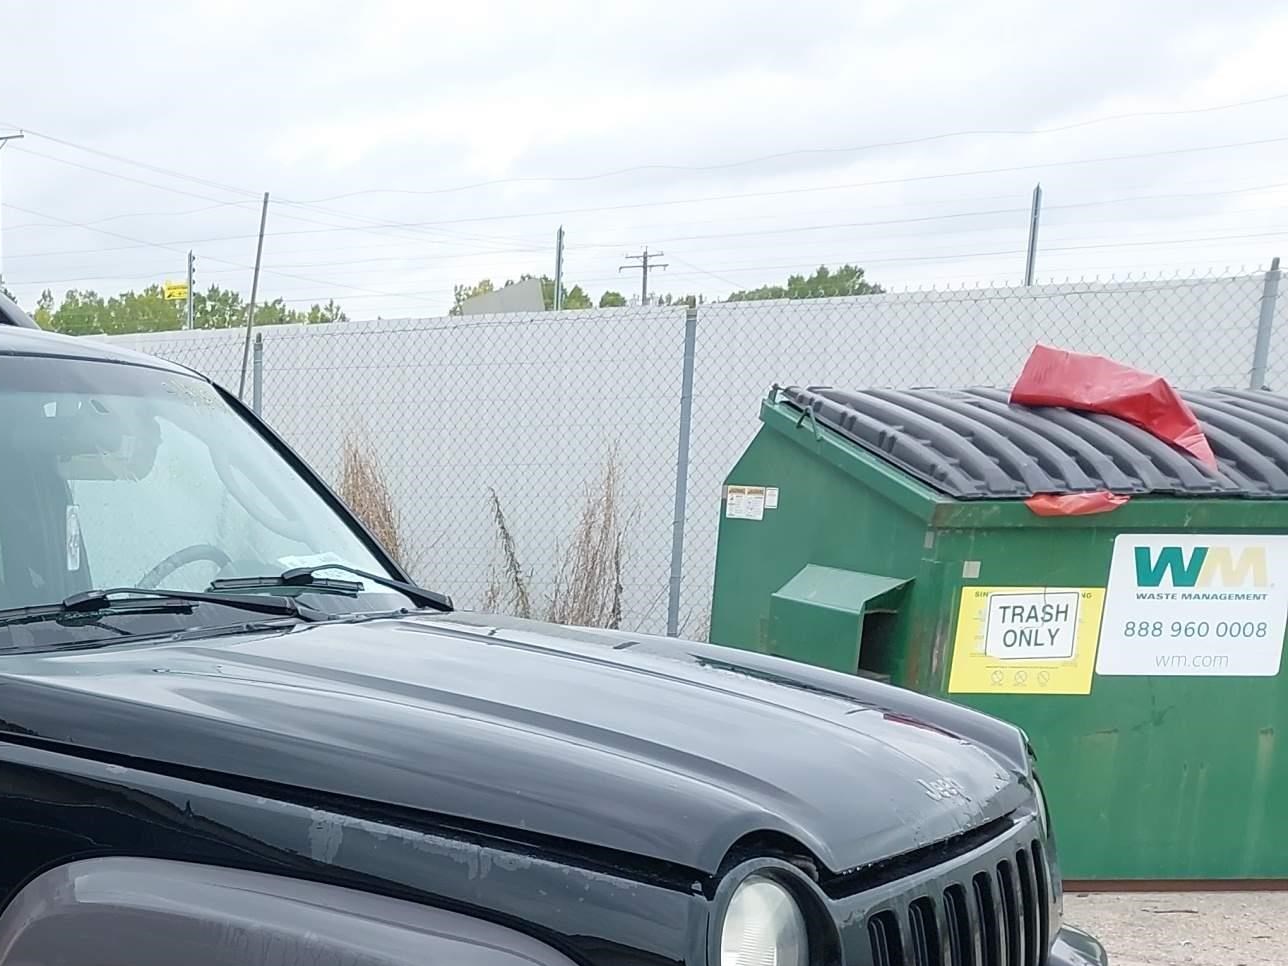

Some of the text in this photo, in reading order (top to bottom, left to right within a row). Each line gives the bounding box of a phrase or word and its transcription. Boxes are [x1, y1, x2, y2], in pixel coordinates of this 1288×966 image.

[1134, 546, 1269, 588] WM
[1136, 592, 1269, 601] WASTE MANAGEMENT
[999, 603, 1069, 624] TRASH
[1002, 628, 1060, 648] ONLY
[1124, 621, 1268, 638] 888 960 0008
[1155, 655, 1229, 668] wm.com
